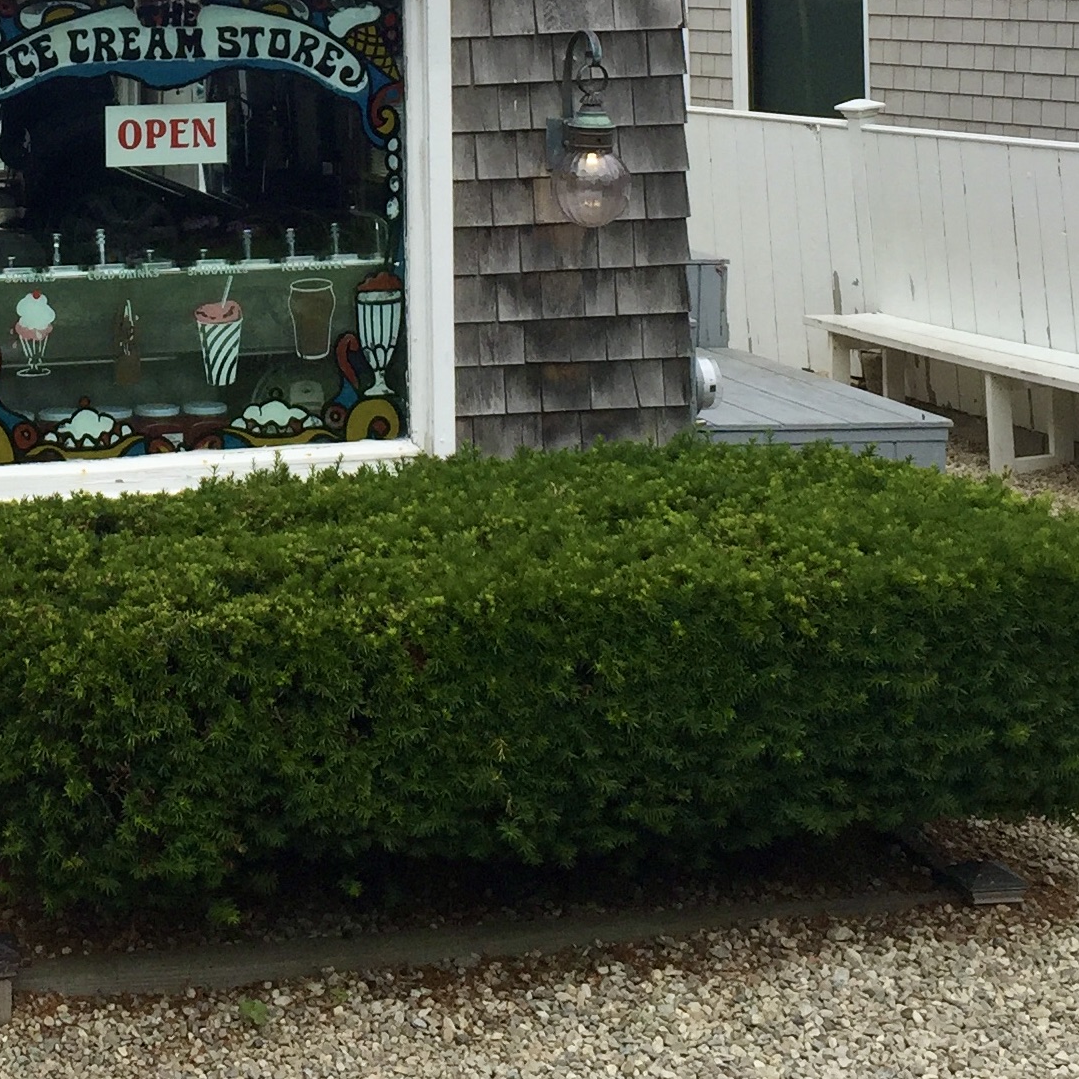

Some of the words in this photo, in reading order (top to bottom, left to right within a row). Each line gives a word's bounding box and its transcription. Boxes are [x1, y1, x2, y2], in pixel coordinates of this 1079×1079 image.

[67, 27, 206, 63] CREAM
[216, 26, 344, 77] STORE
[117, 117, 217, 150] OPEN
